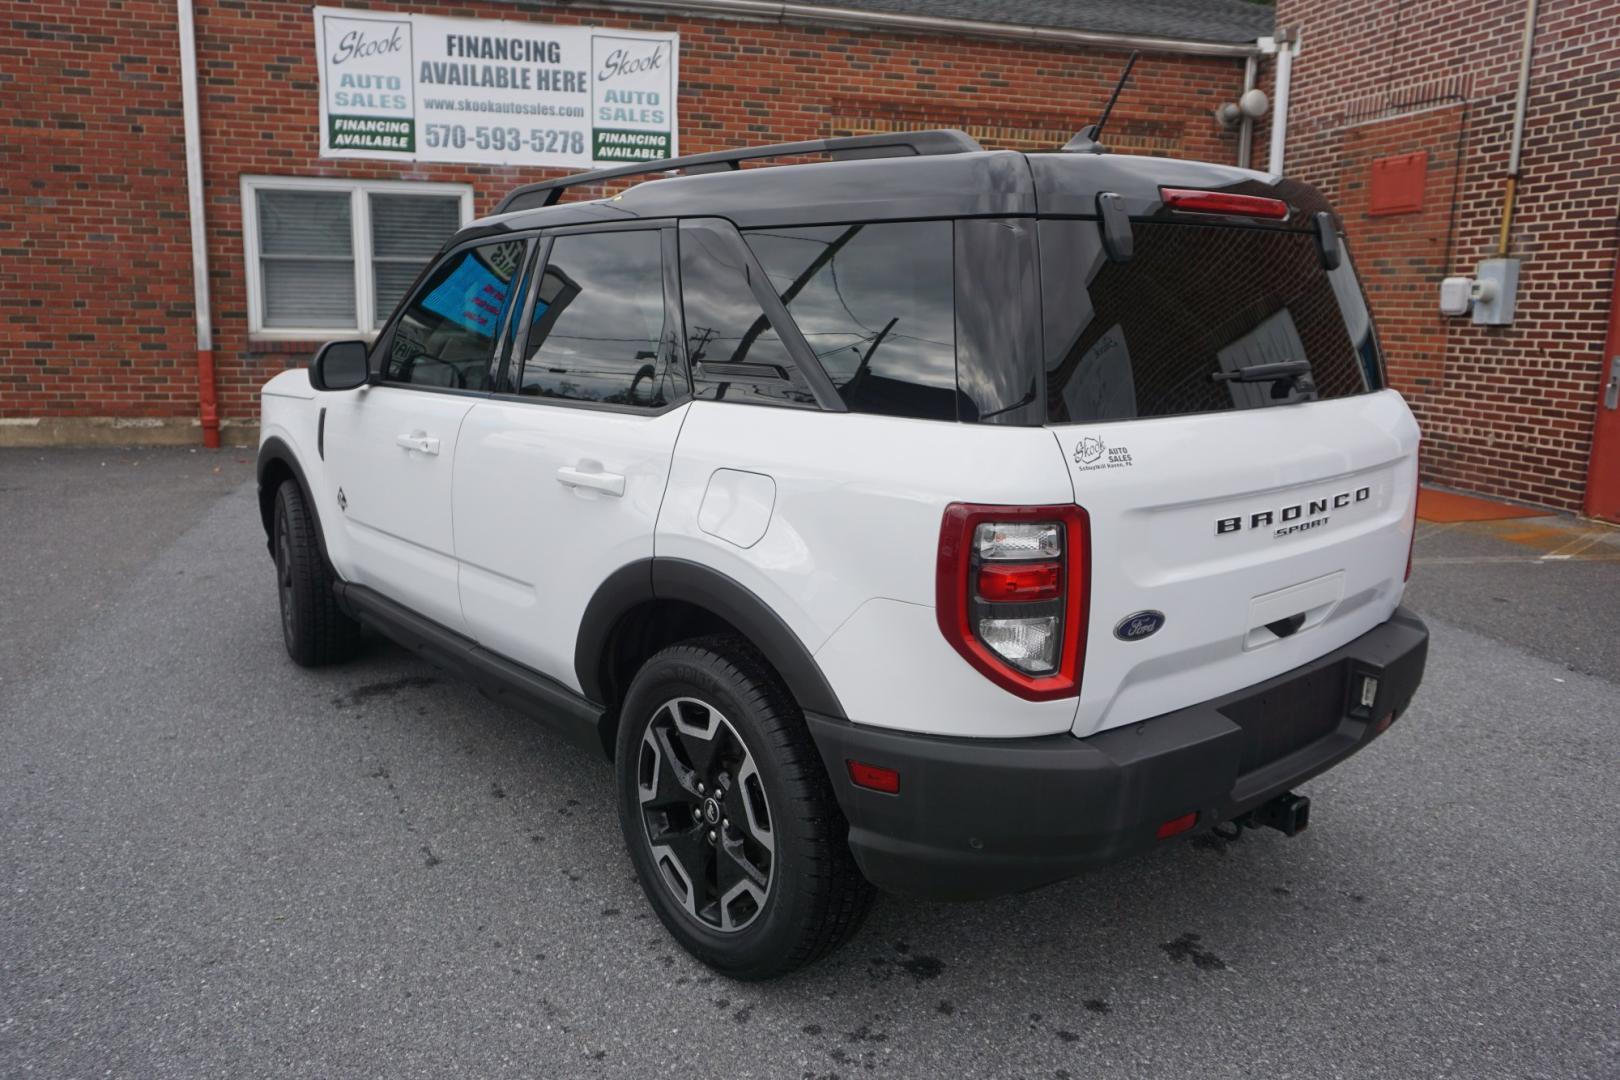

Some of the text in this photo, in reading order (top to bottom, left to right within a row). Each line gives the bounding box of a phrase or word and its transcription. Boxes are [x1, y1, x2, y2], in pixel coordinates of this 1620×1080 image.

[332, 26, 402, 65] Skook
[447, 34, 561, 64] FINANCING
[598, 45, 663, 82] Skook
[340, 73, 400, 91] AUTO
[419, 61, 587, 93] AVAILABLE HERE
[334, 91, 407, 110] SALES
[604, 89, 660, 106] AUTO
[424, 98, 585, 118] www.skookautosales.com
[599, 107, 665, 124] SALES
[334, 119, 410, 133] FINANCING
[335, 134, 409, 148] AVAILABLE
[425, 123, 585, 155] 570-593-5278
[598, 132, 667, 146] FINANCING
[598, 147, 665, 159] AVAILABLE
[1108, 447, 1128, 455] AUTO
[1215, 487, 1371, 535] BRONCO
[1274, 516, 1331, 538] SPORT
[1128, 616, 1157, 637] Ford
